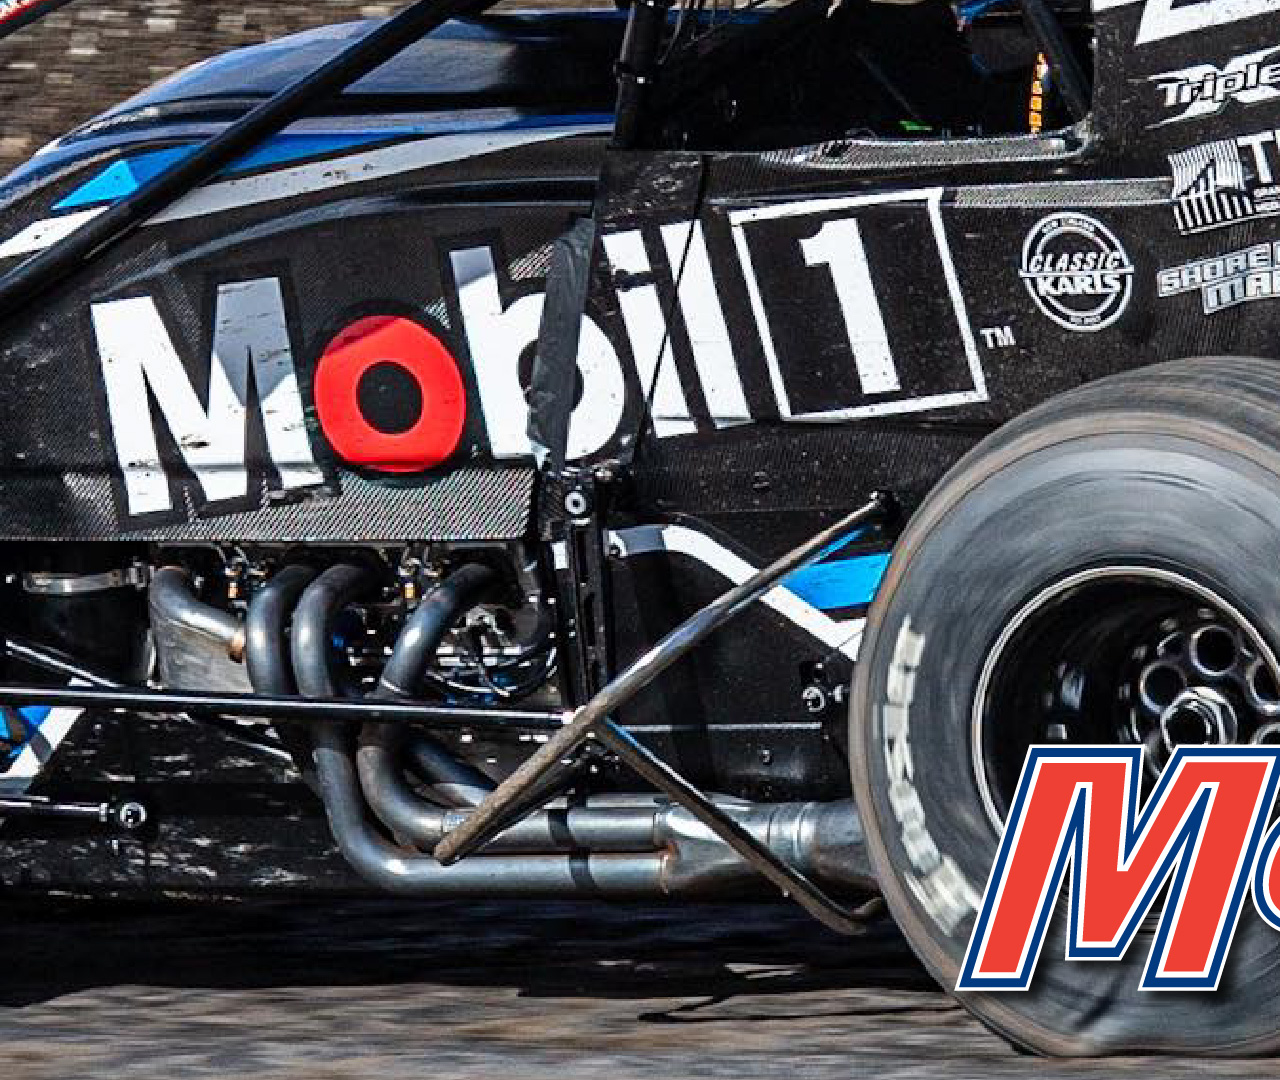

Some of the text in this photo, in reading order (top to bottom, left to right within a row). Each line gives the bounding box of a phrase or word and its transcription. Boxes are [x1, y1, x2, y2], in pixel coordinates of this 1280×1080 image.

[1029, 251, 1122, 271] CLASSIC
[981, 327, 1014, 349] TM
[91, 219, 900, 516] Mobil 1
